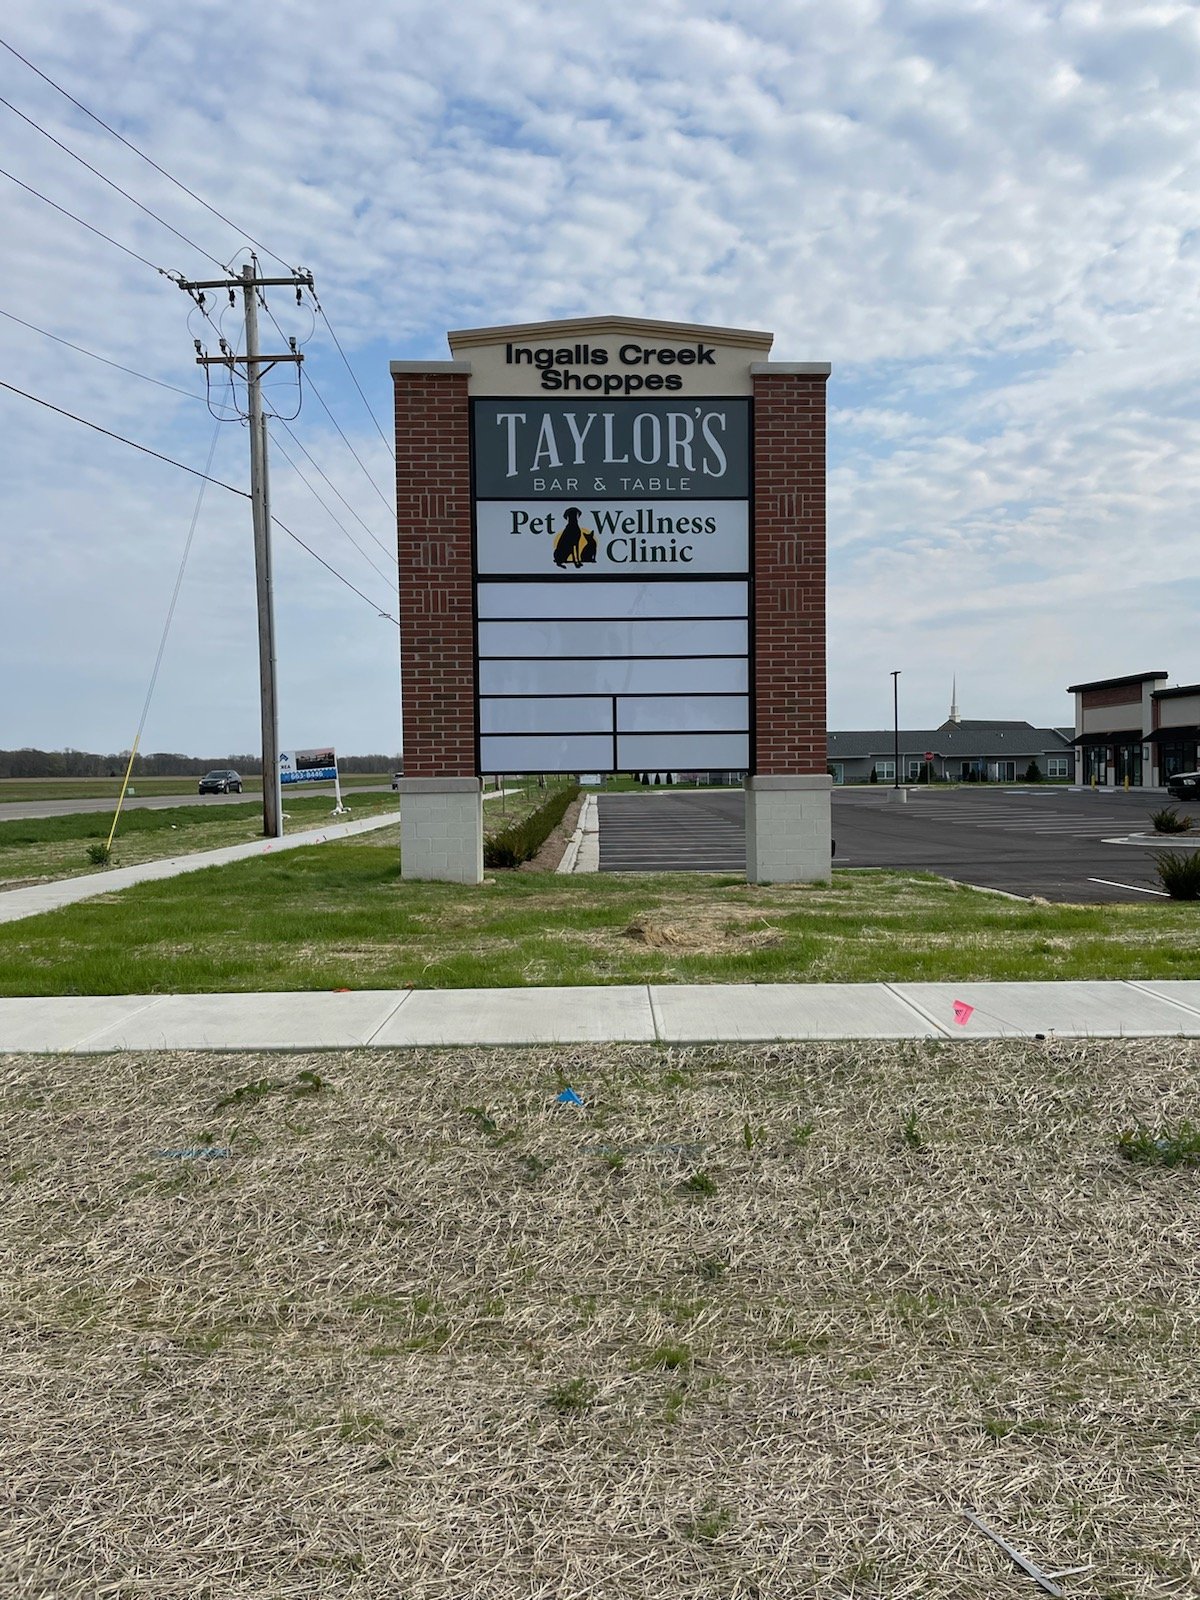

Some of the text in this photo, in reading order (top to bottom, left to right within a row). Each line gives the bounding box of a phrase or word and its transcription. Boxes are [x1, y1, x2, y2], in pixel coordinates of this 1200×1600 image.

[506, 343, 716, 370] Ingalls Creek
[541, 369, 683, 395] Shoppes
[496, 407, 727, 477] TAYLOR'S
[533, 477, 691, 491] BAR & TABLE
[510, 509, 717, 535] Pet Wellness
[606, 538, 693, 563] Clinic
